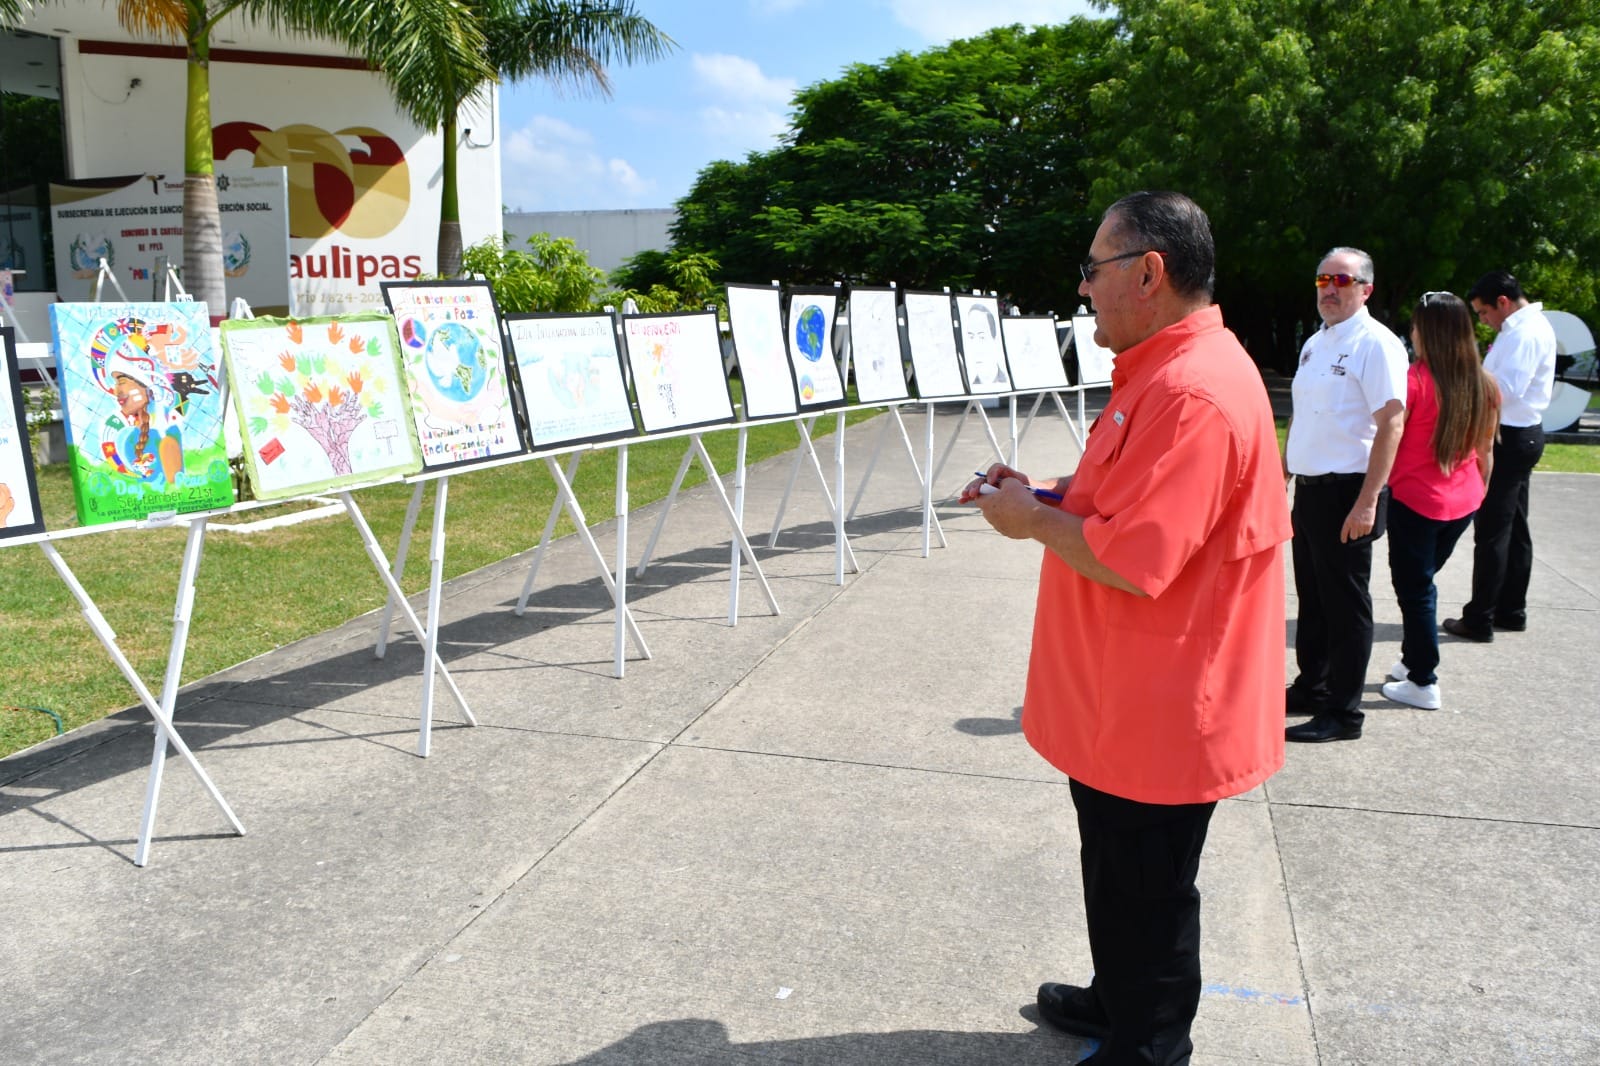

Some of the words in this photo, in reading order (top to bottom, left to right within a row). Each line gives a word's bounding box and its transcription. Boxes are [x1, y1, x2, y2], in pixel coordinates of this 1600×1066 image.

[105, 207, 113, 216] DE
[150, 205, 158, 215] DE
[160, 204, 183, 214] SANCIO
[218, 202, 245, 212] SERCIÓN
[160, 227, 184, 236] CARTELE
[290, 245, 421, 286] aulipas
[320, 292, 385, 304] 1824-202
